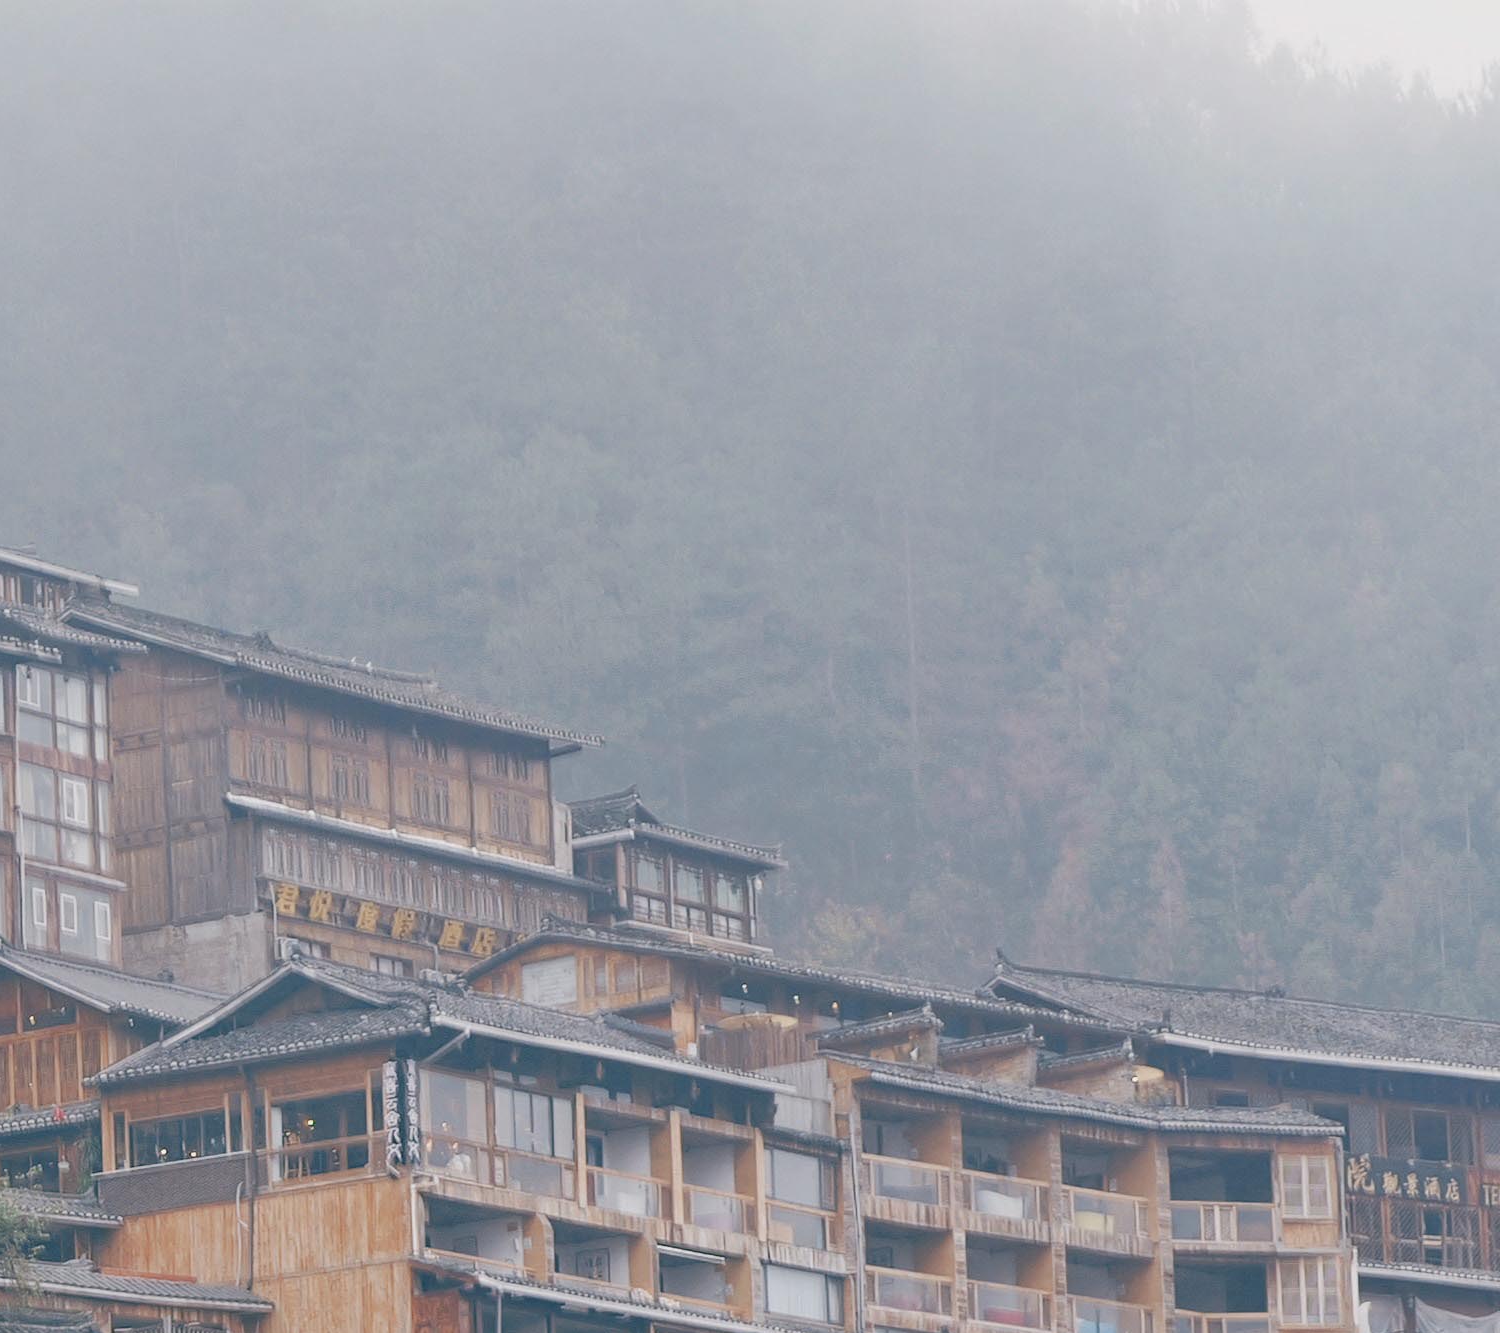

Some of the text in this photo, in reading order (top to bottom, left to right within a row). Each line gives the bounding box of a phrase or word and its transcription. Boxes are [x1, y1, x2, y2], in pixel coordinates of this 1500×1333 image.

[276, 883, 498, 957] 君悦度假酒店
